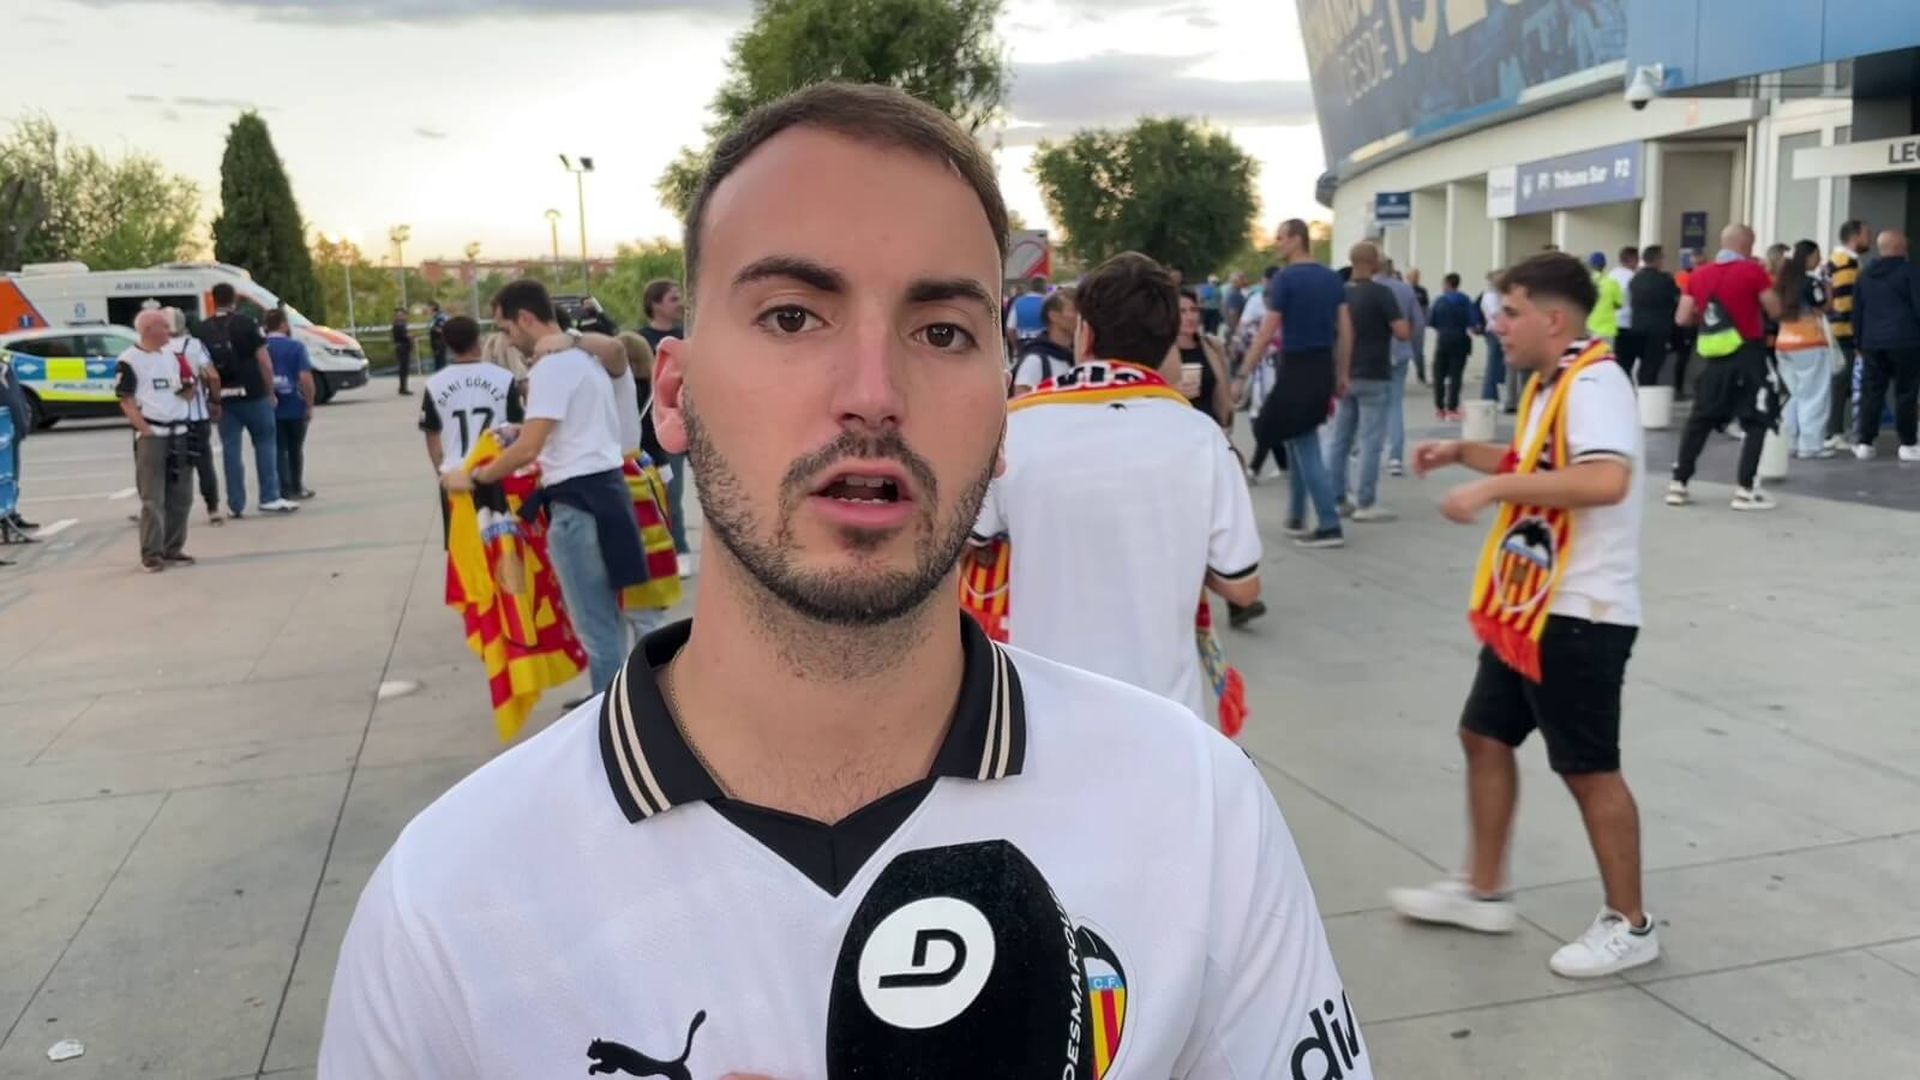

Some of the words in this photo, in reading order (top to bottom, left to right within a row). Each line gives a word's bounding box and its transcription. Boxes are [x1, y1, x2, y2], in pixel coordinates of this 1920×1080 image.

[116, 280, 195, 290] AMBULANCIA
[452, 407, 495, 459] 17
[1093, 977, 1120, 989] C.F.
